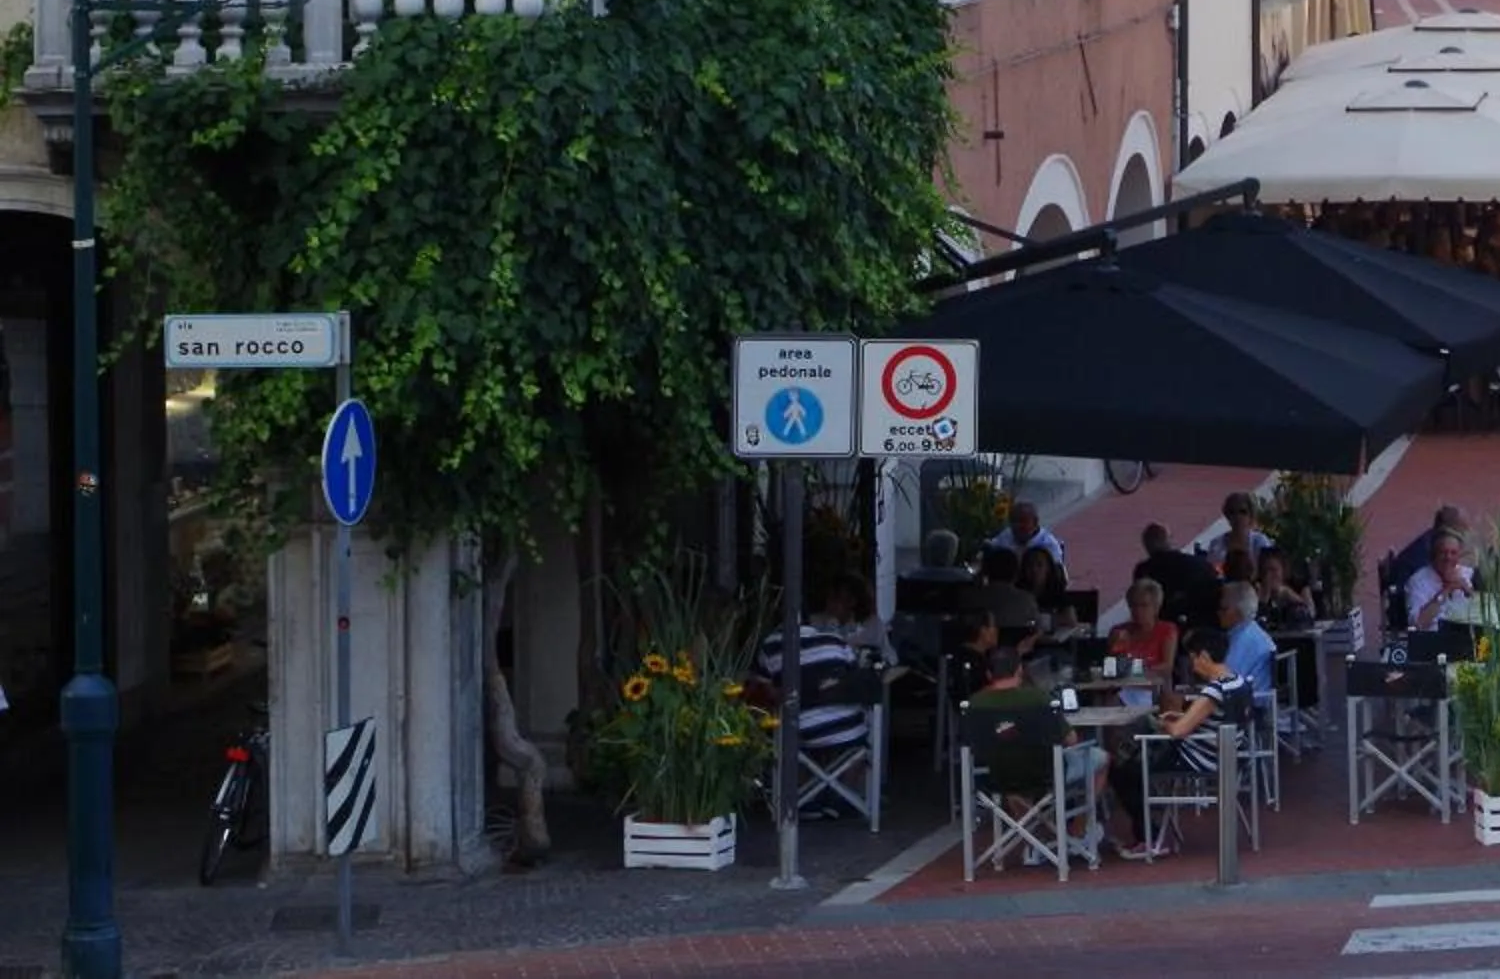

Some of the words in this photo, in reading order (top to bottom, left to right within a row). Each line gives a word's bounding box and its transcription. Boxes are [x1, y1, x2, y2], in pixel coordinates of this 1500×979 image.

[178, 340, 220, 356] san
[235, 339, 305, 356] rocco
[778, 348, 813, 359] area
[758, 364, 832, 380] pedonale
[889, 424, 949, 436] eccet
